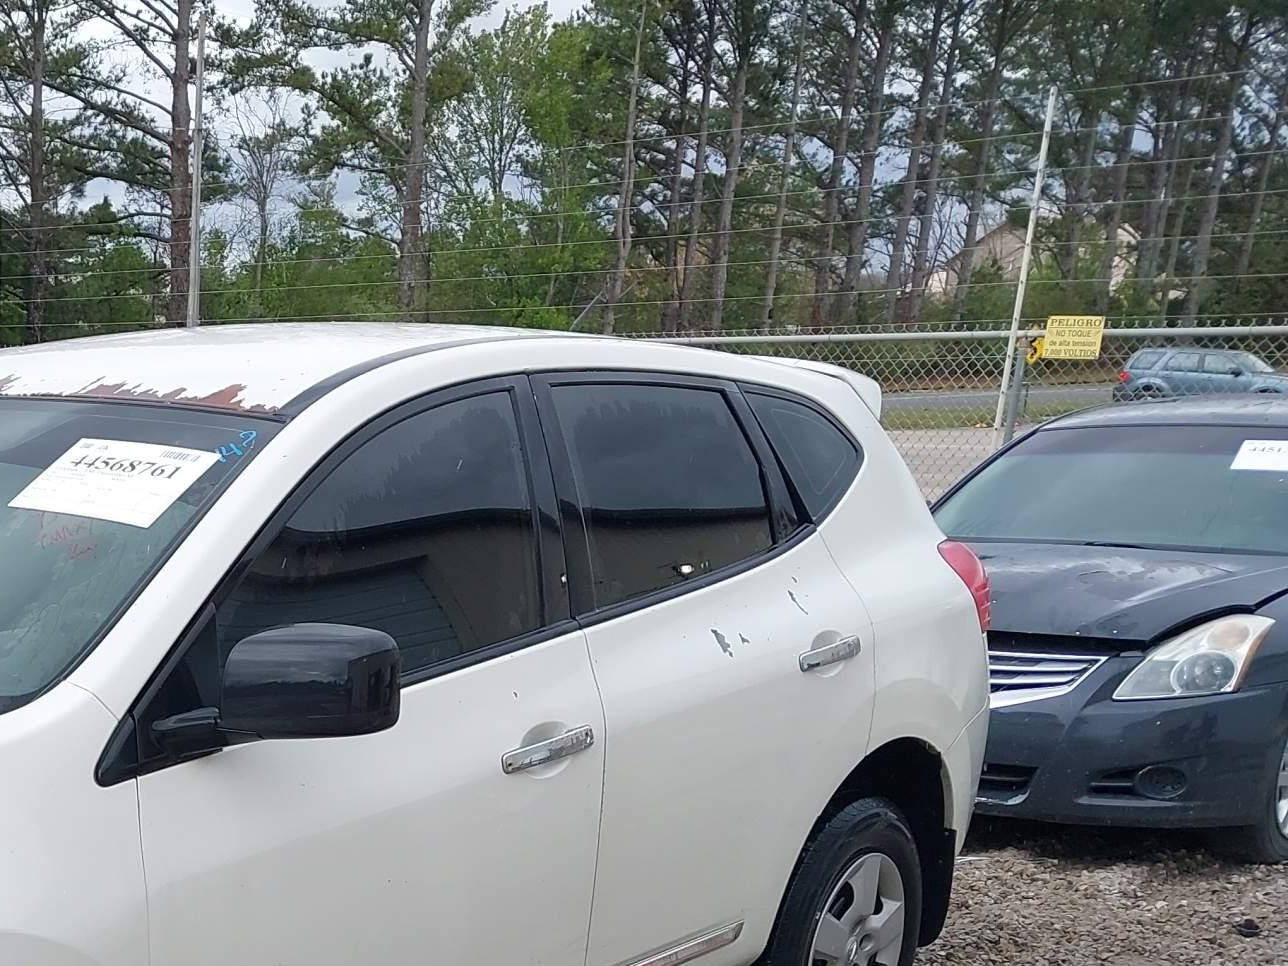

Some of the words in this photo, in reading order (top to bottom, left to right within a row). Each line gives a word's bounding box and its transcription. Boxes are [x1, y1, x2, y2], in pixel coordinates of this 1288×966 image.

[1050, 318, 1102, 327] PELIGRO
[1055, 329, 1066, 337] NO
[1068, 329, 1092, 338] TOQUE
[1063, 348, 1097, 358] VOLTIOS
[71, 454, 182, 479] 44568761
